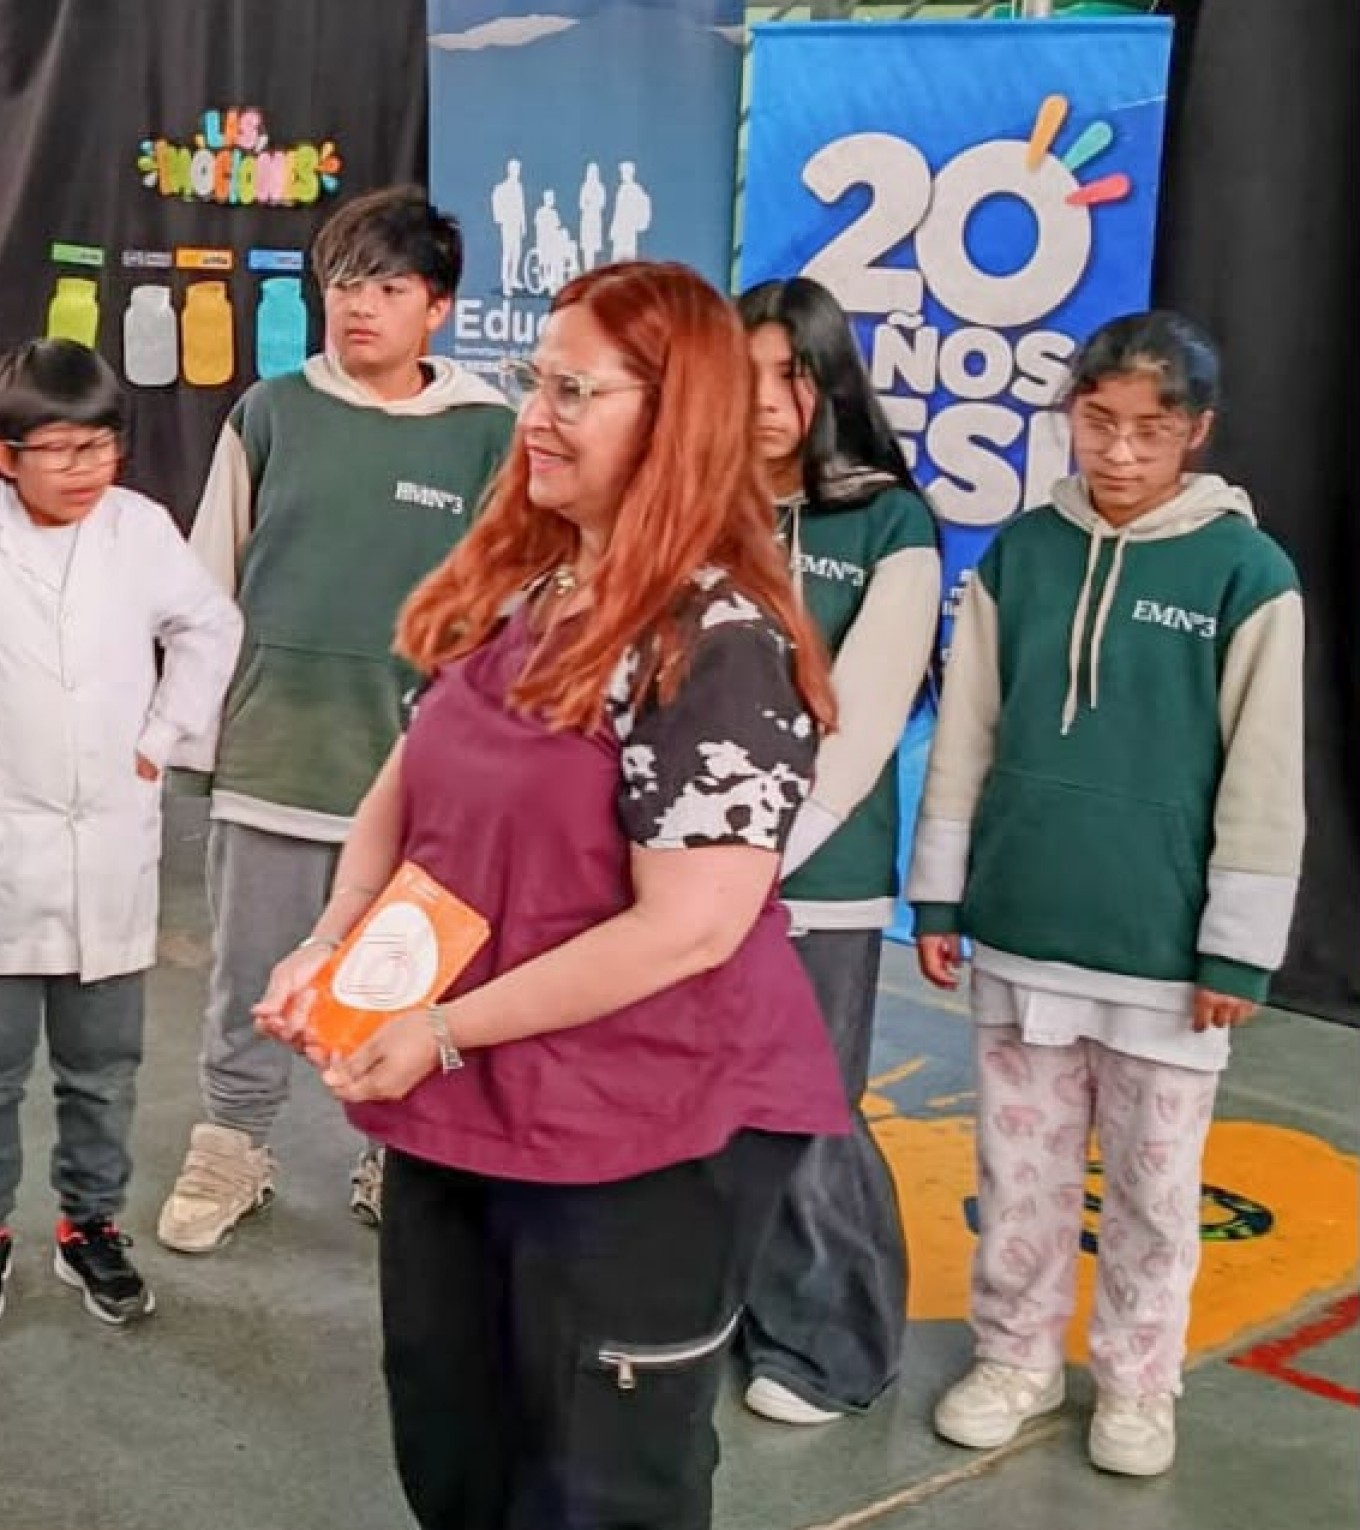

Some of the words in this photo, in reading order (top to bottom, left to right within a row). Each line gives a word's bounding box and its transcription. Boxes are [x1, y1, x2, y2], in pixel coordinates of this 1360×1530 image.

[203, 107, 262, 150] LAS
[801, 132, 1092, 327] 20
[872, 311, 1076, 407] ÑOS
